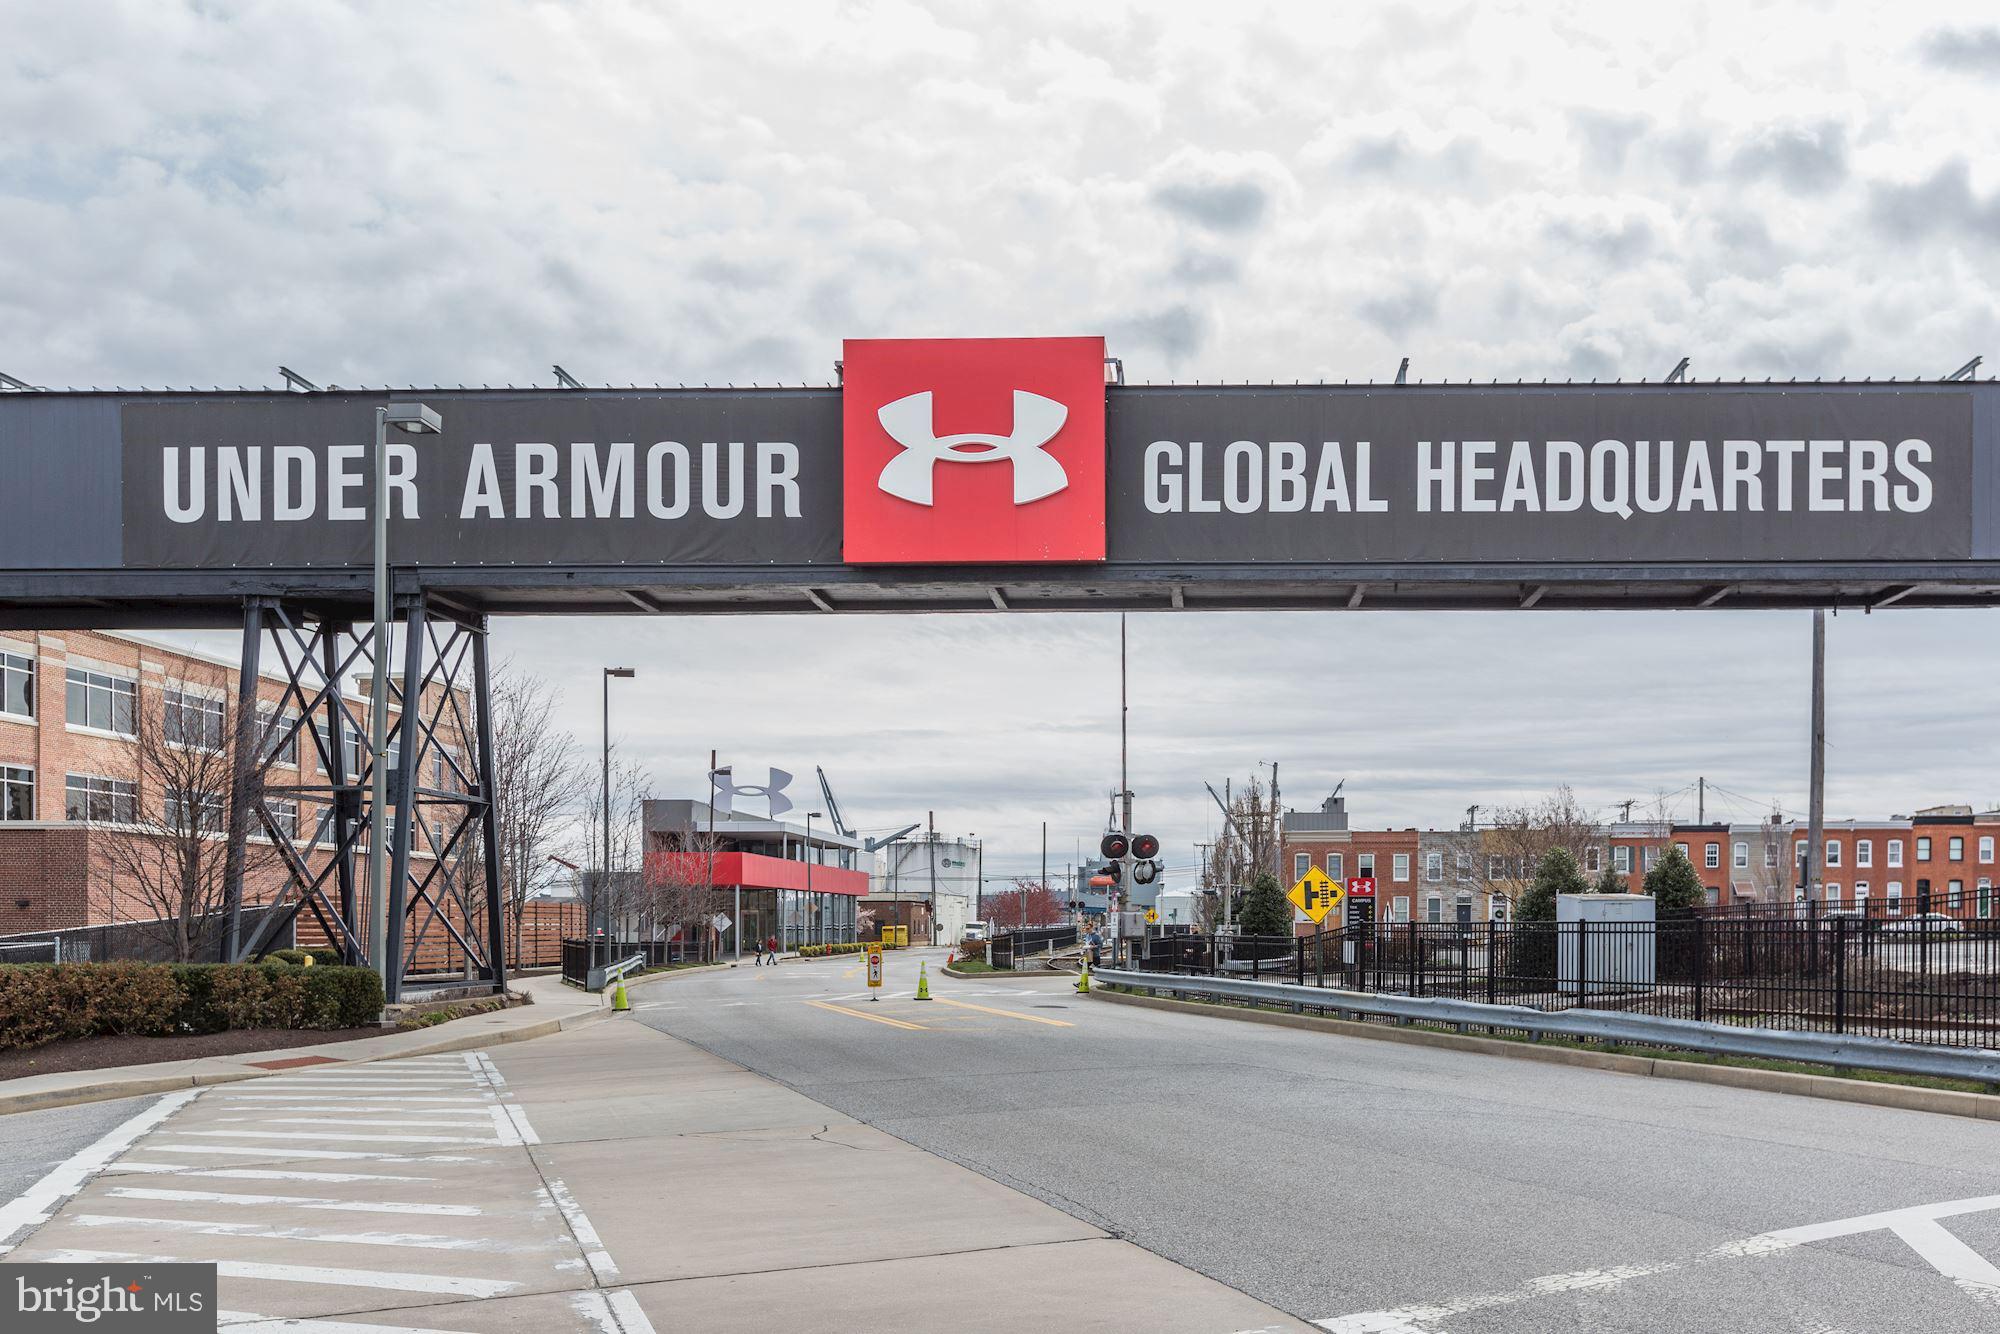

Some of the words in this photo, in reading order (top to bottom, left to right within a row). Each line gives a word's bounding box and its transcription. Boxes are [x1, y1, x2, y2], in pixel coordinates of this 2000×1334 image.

[163, 444, 421, 524] UNDER
[459, 441, 803, 520] ARMOUR
[1143, 440, 1389, 514] GLOBAL
[1416, 438, 1933, 521] HEADQUARTERS
